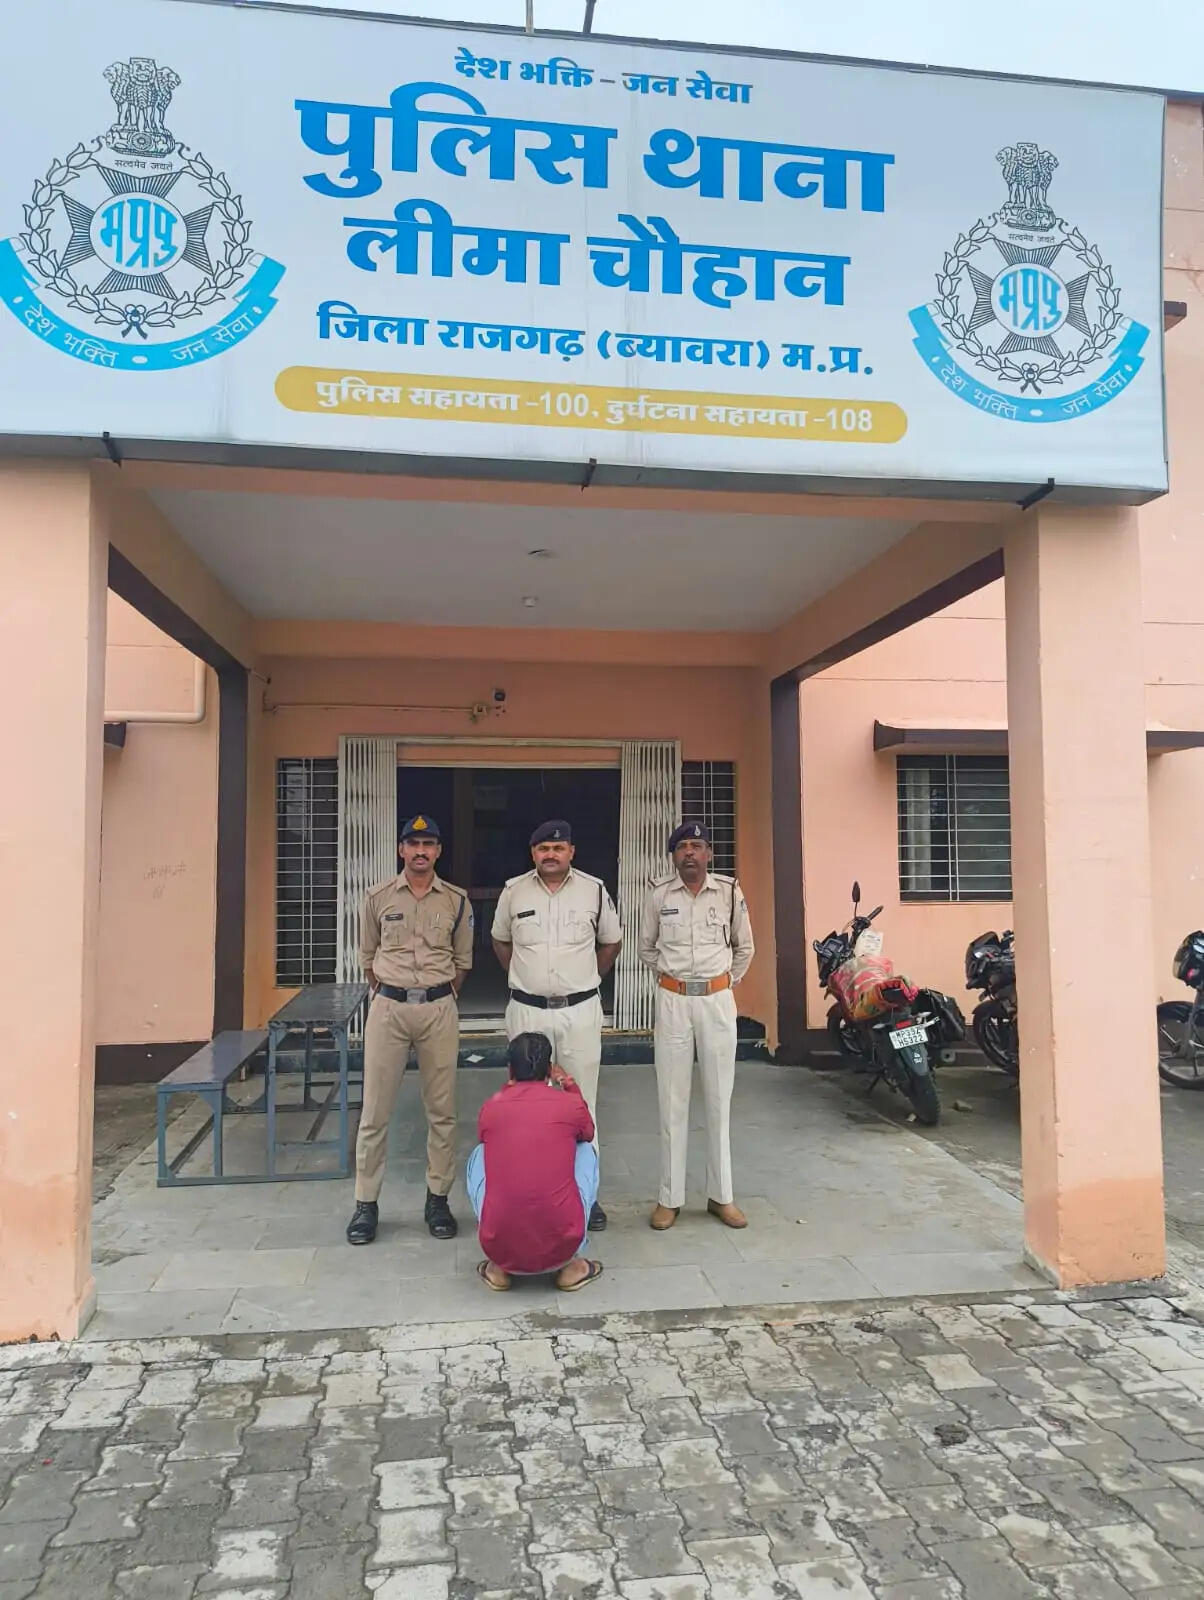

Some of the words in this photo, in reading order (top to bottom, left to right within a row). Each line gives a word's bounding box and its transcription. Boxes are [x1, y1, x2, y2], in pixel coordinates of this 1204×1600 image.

[454, 46, 512, 81] देश
[519, 57, 595, 88] भक्ति
[622, 72, 680, 97] जन
[686, 70, 754, 104] सेवा
[294, 81, 618, 199] पुलिस
[642, 128, 895, 213] थाना
[342, 198, 571, 286] लीमा
[586, 213, 852, 309] चौहान
[24, 303, 58, 337] देश
[63, 332, 119, 368] भक्ति
[170, 340, 210, 361] जन
[211, 312, 255, 345] सेवा
[316, 300, 429, 346] जिला
[437, 319, 586, 362] राजगढ़
[597, 329, 770, 370] (ब्यावरा)
[781, 343, 873, 375] म.प्र.
[315, 376, 402, 408] पुलिस
[408, 387, 521, 411] सहायता
[605, 394, 700, 425] दुर्घटना
[704, 404, 809, 428] सहायता
[940, 364, 968, 392] देश
[973, 388, 1019, 420] भक्ति
[1061, 393, 1091, 416] जन
[1093, 369, 1128, 400] सेवा
